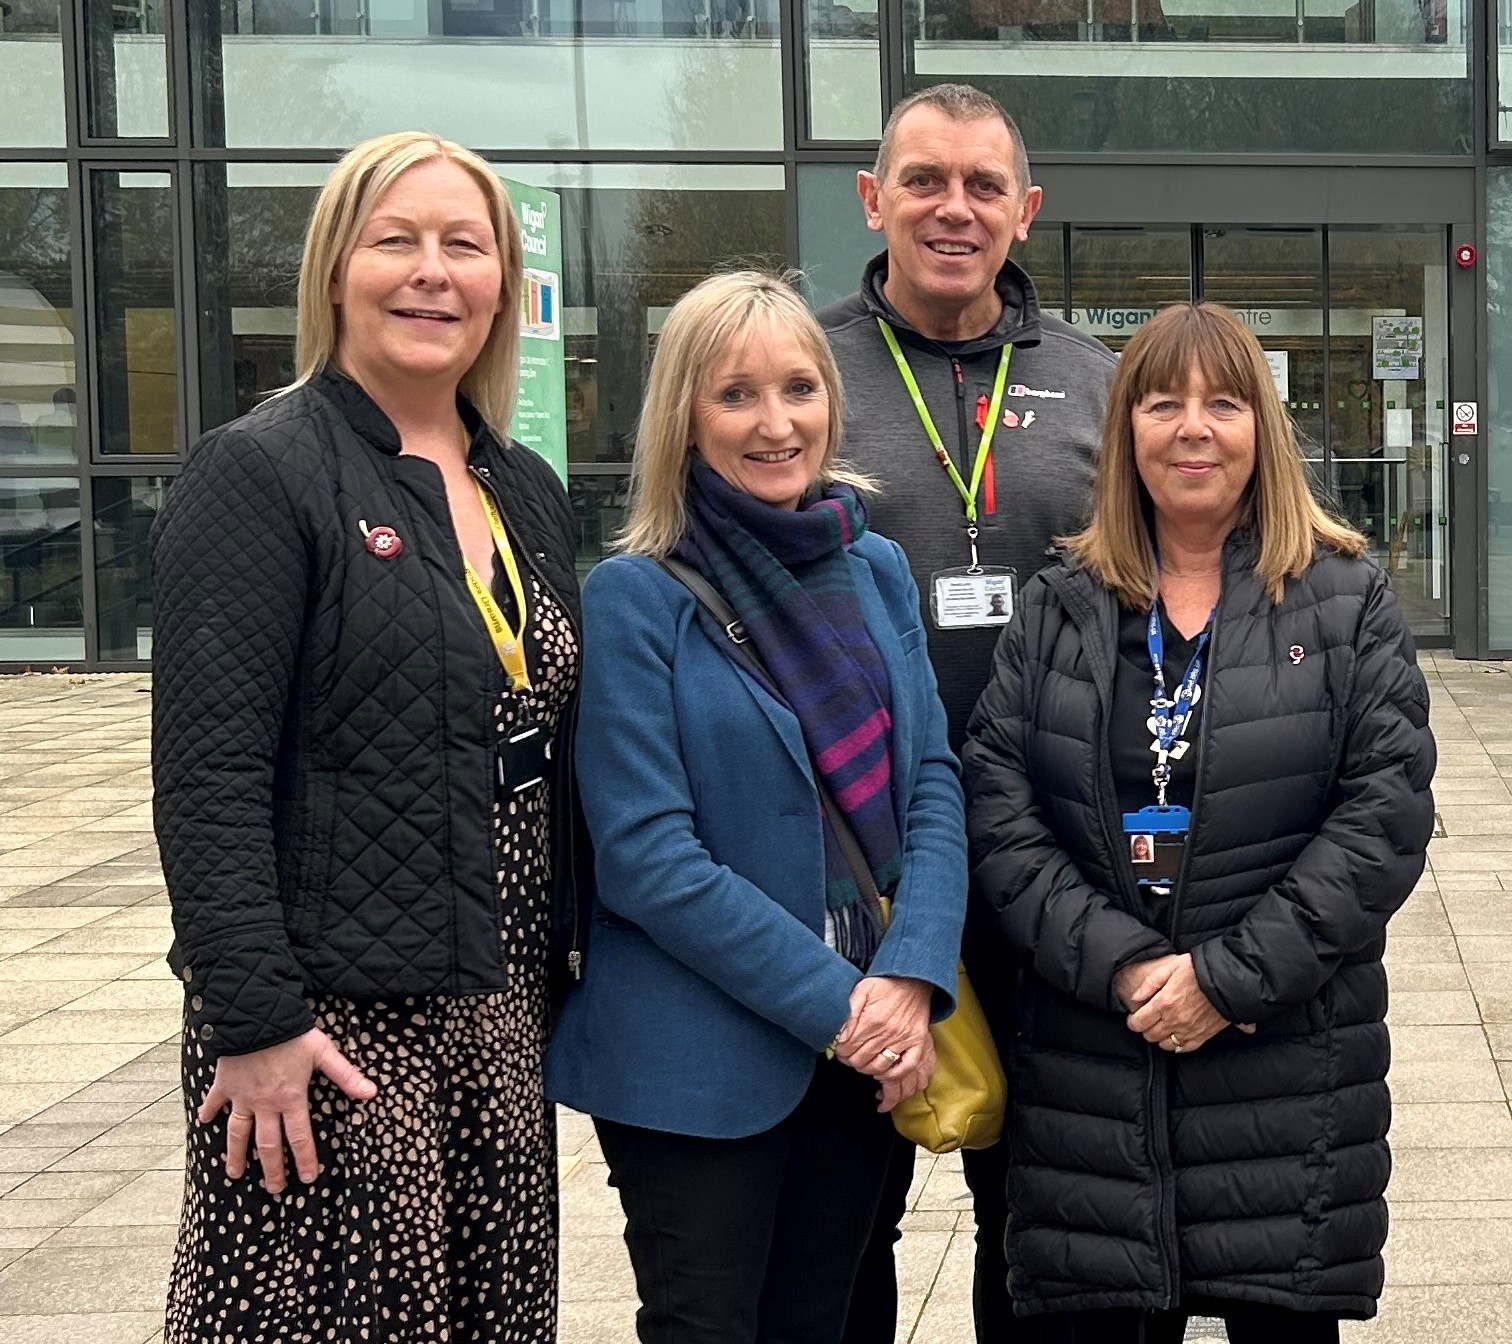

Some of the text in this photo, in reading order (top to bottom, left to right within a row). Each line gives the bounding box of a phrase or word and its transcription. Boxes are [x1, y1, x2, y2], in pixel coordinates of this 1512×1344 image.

[521, 201, 545, 233] Wigan
[1086, 307, 1151, 329] Wigan
[1234, 309, 1271, 325] ntre
